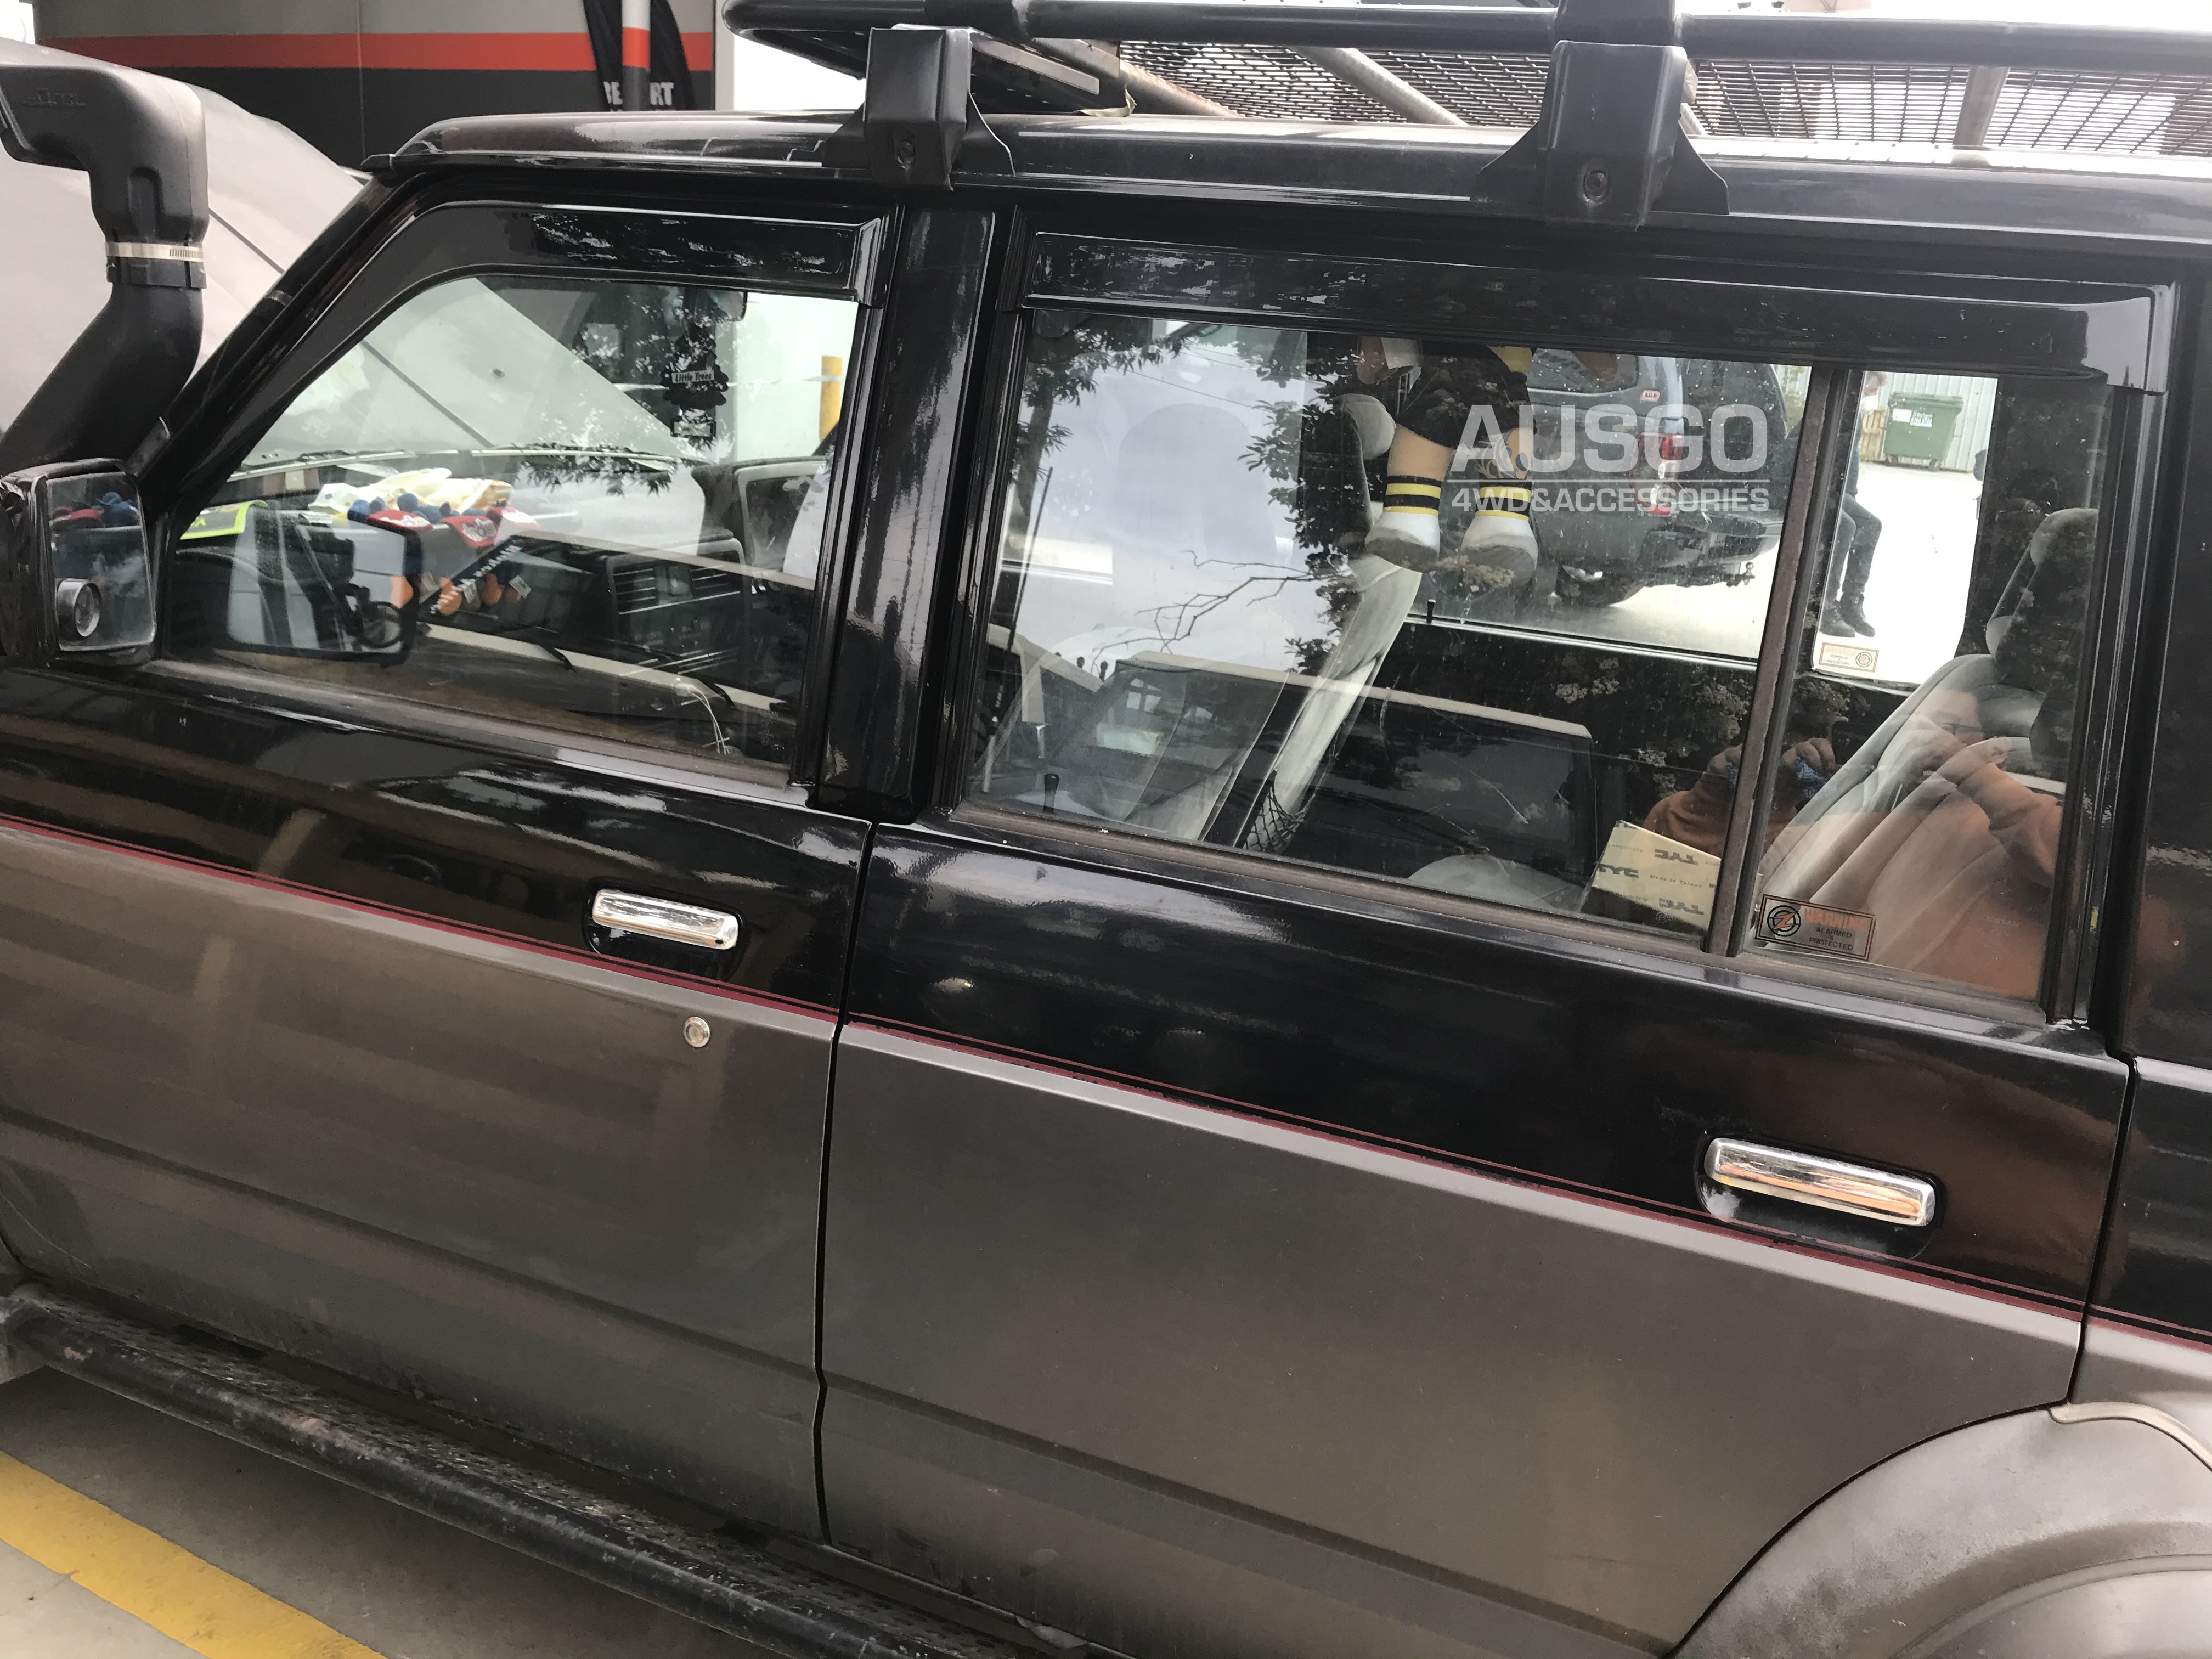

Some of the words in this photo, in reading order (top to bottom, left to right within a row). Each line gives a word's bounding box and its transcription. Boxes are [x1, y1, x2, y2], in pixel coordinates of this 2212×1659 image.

[675, 373, 693, 382] Little
[695, 372, 712, 380] Trees
[1654, 848, 1699, 866] TYC
[1597, 864, 1639, 879] TYC
[1680, 879, 1702, 888] Taiwan
[1804, 908, 1865, 932] WARNING
[1816, 926, 1852, 938] ALARMED
[1809, 937, 1854, 951] PROTECTED
